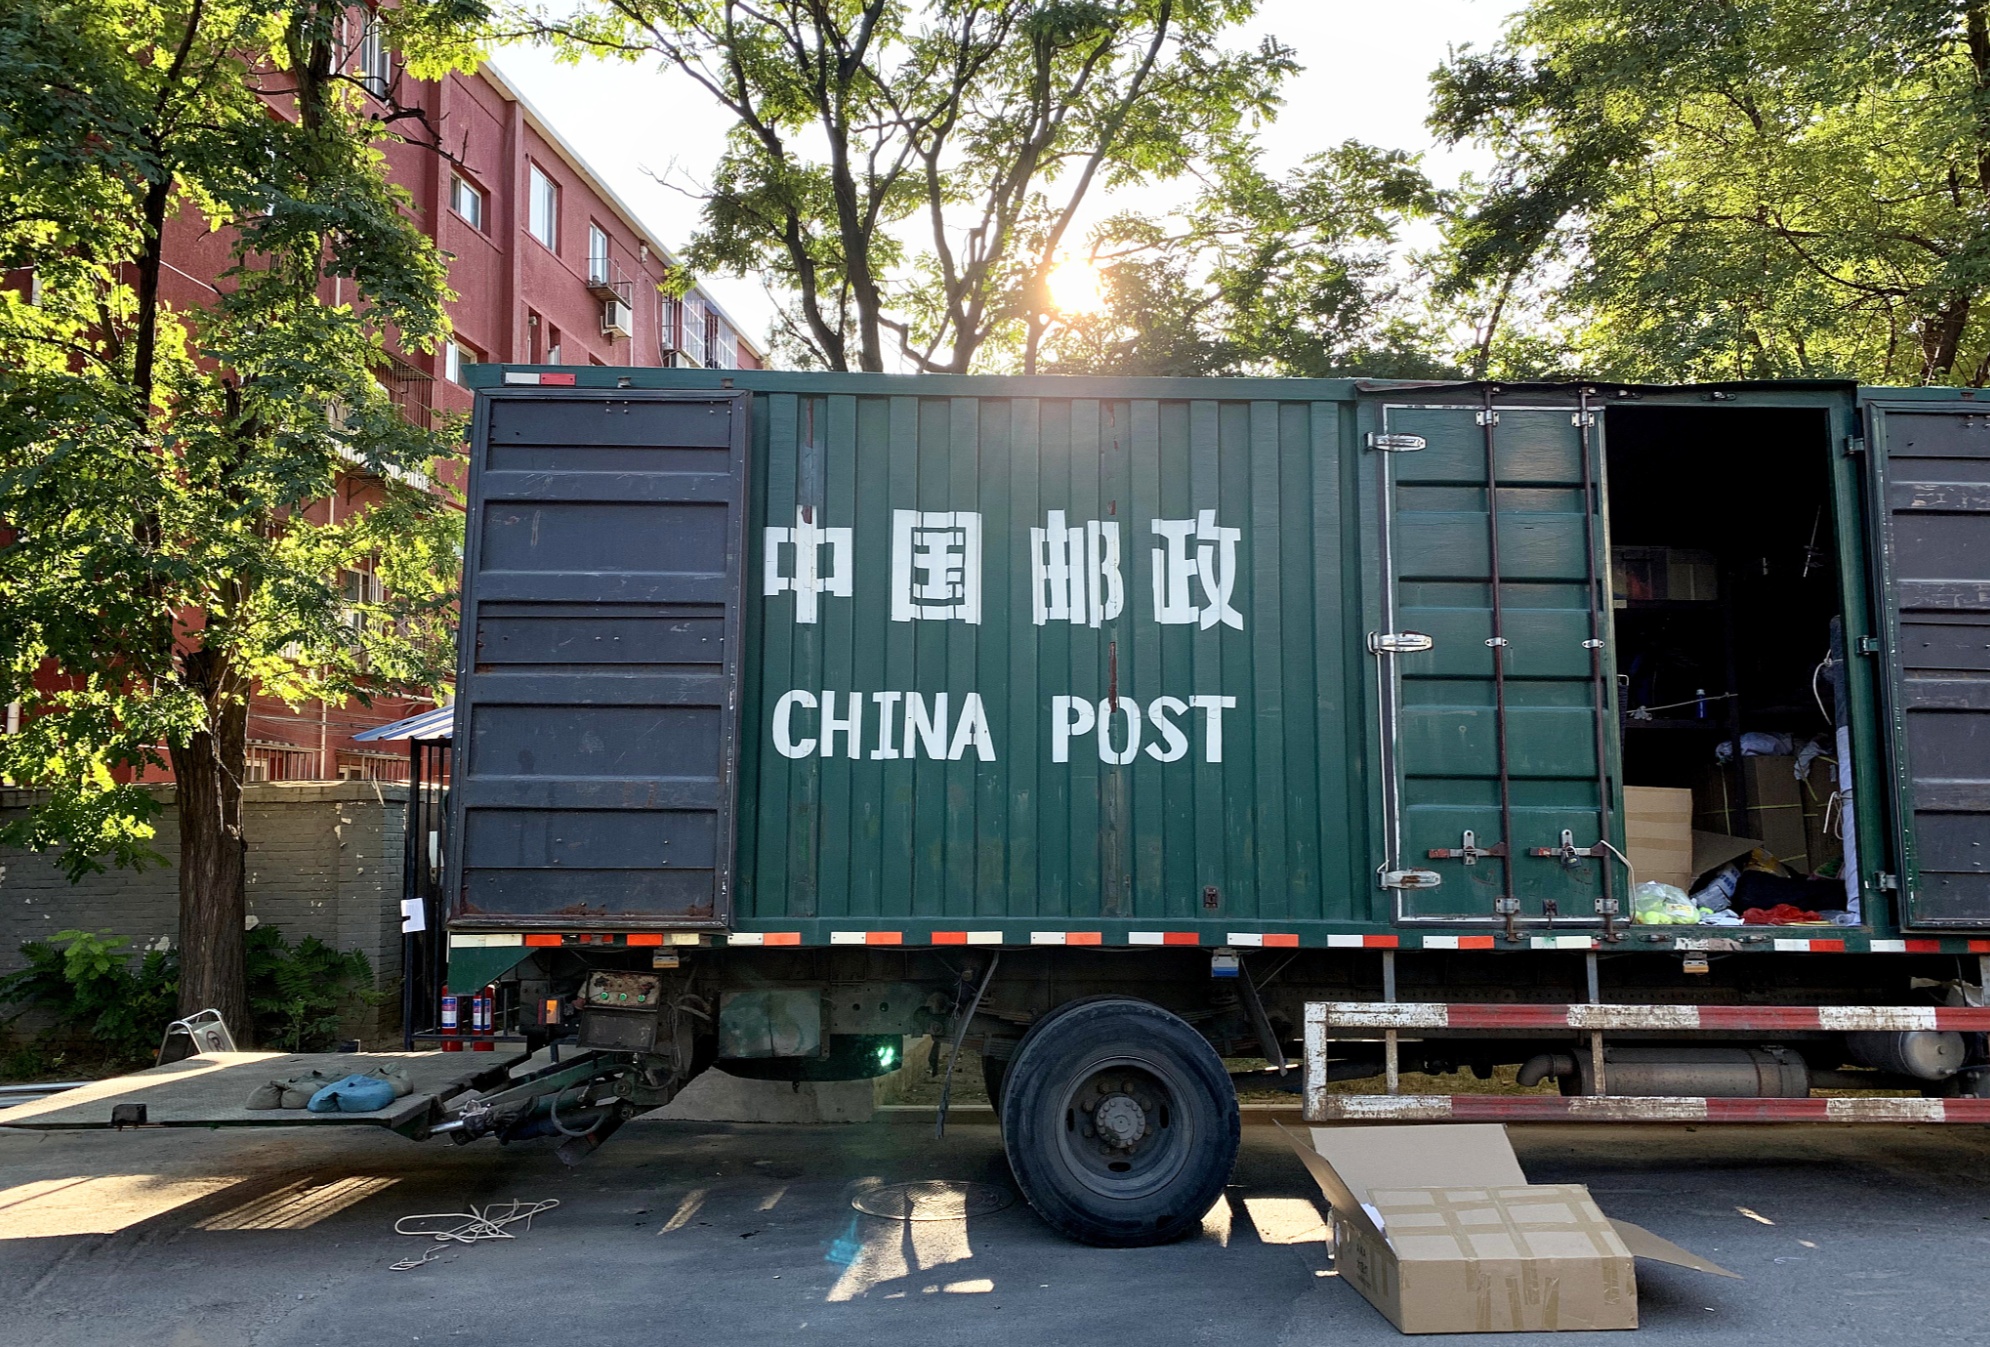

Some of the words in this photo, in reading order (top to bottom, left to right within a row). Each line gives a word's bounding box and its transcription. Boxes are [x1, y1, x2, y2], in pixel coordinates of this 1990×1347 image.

[763, 505, 1243, 630] 中国邮政
[772, 690, 996, 761] CHINA
[1052, 695, 1236, 765] POST
